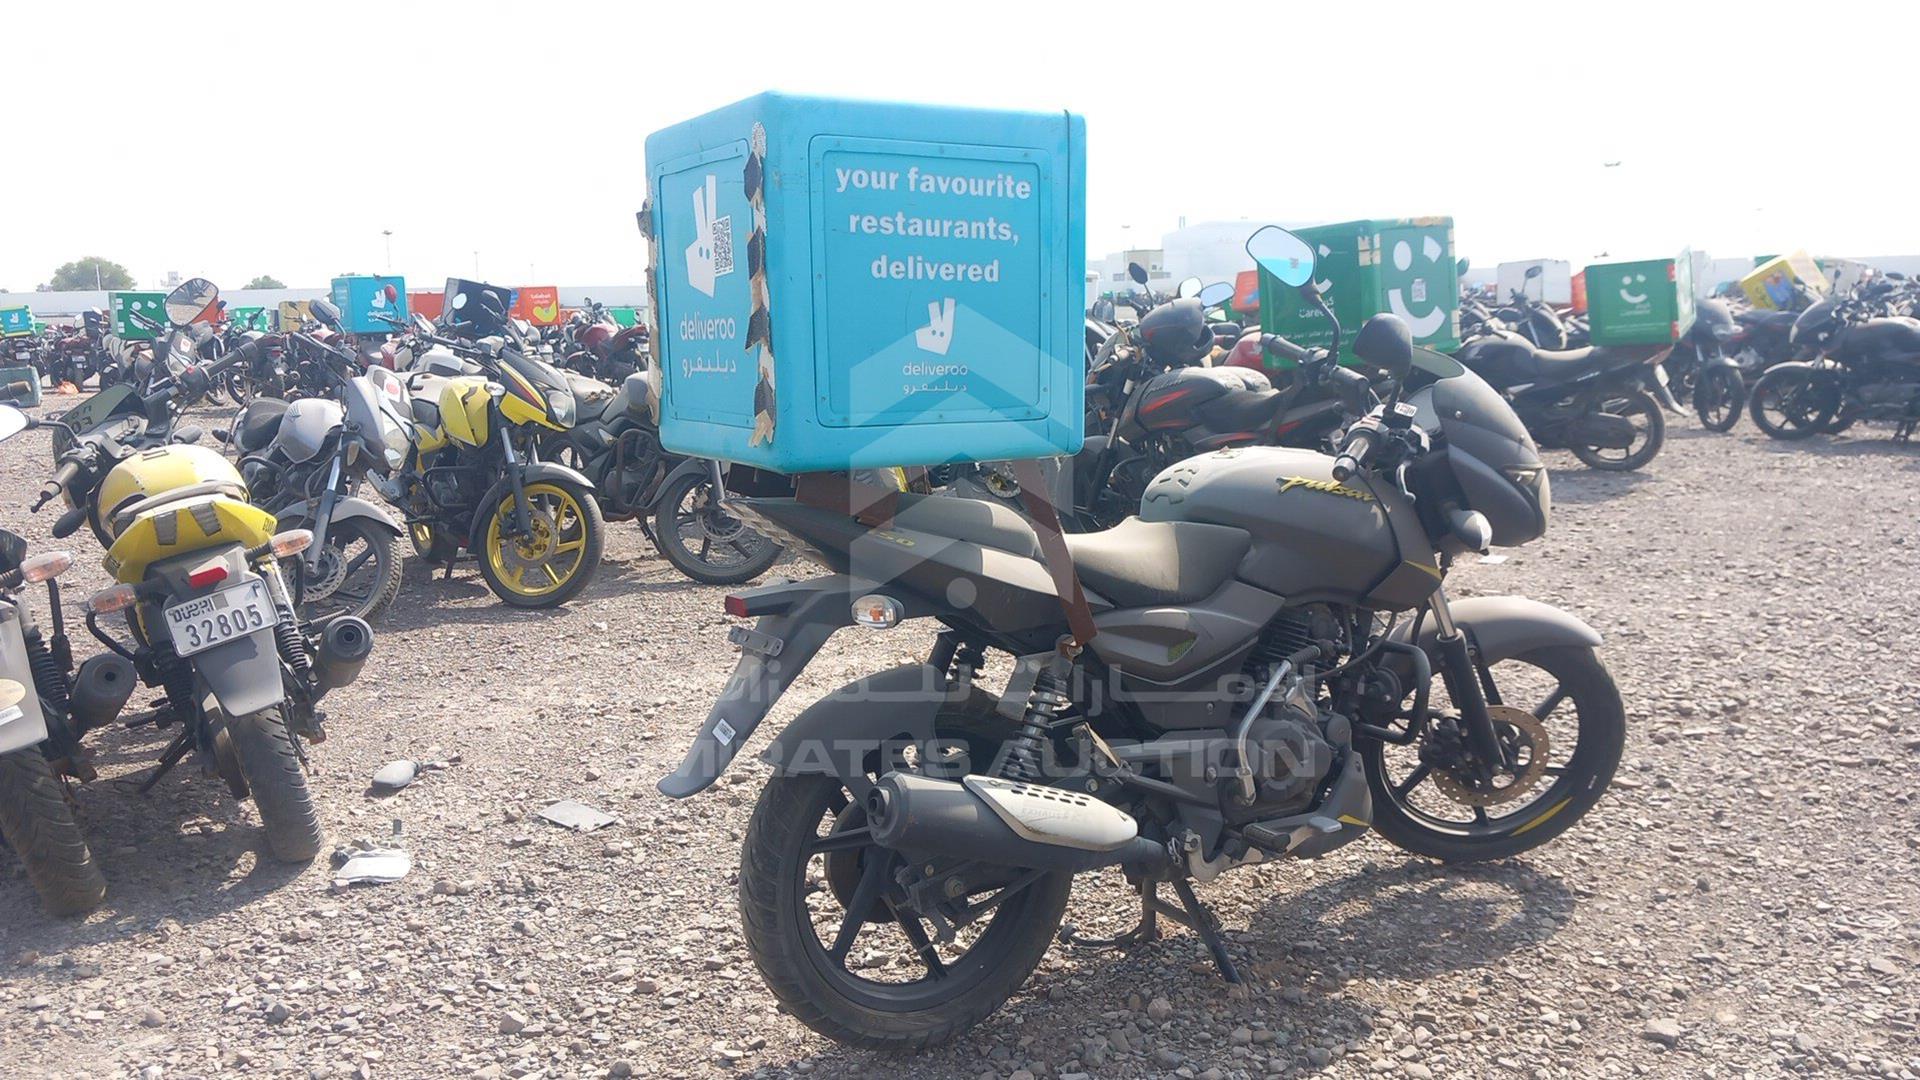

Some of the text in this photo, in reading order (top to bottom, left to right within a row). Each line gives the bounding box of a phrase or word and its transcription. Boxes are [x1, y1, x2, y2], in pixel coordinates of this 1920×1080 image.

[835, 166, 1031, 200] your favourite
[849, 211, 1019, 246] restaurants,
[871, 254, 1000, 282] delivered
[680, 311, 736, 341] deliveroo
[902, 360, 968, 376] deliveroo
[185, 603, 263, 647] 32805
